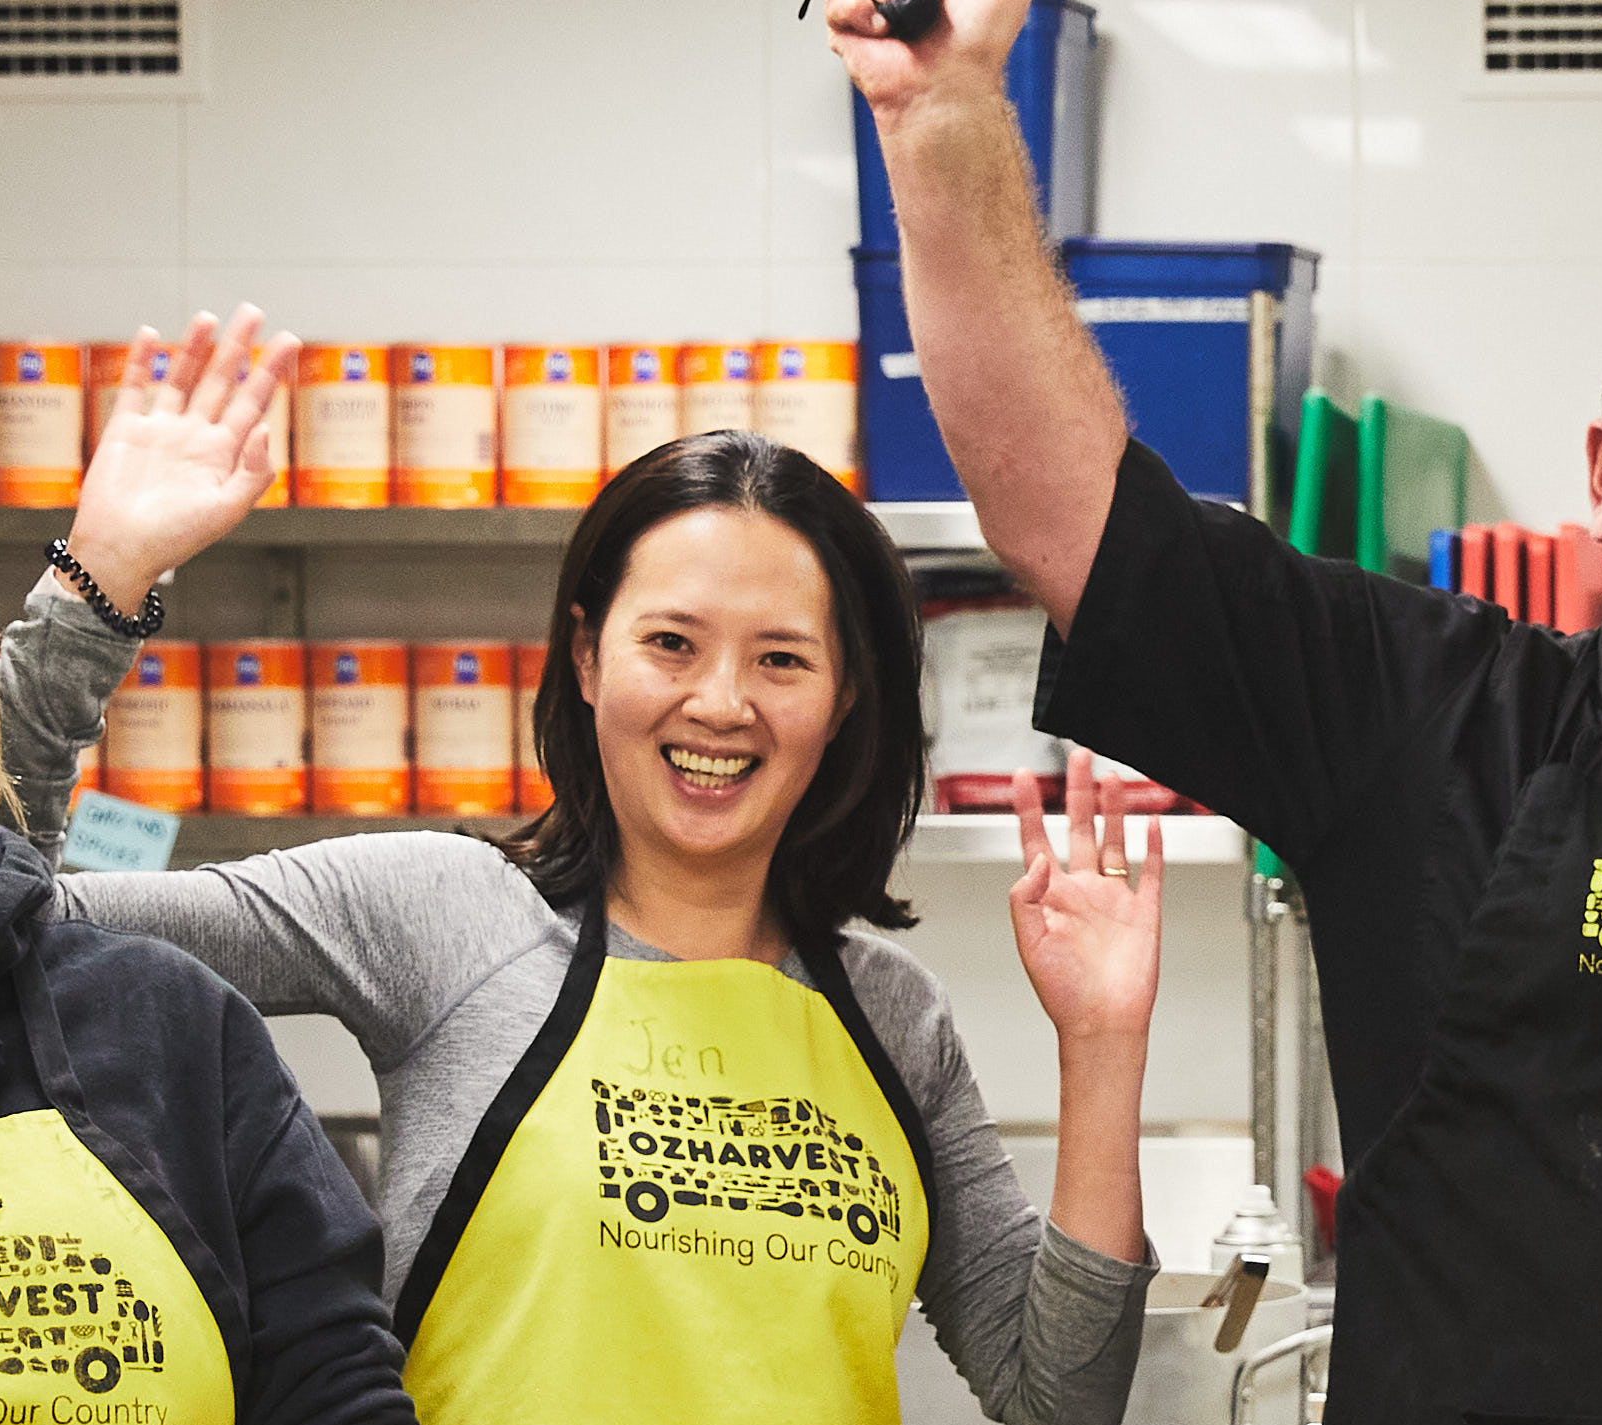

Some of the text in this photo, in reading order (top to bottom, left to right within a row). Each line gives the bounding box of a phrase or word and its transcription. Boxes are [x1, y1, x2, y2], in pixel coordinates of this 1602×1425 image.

[620, 1017, 725, 1080] Jen
[628, 1131, 860, 1179] OZHARVEST
[599, 1219, 754, 1266] Nourishing
[766, 1234, 818, 1262] Our
